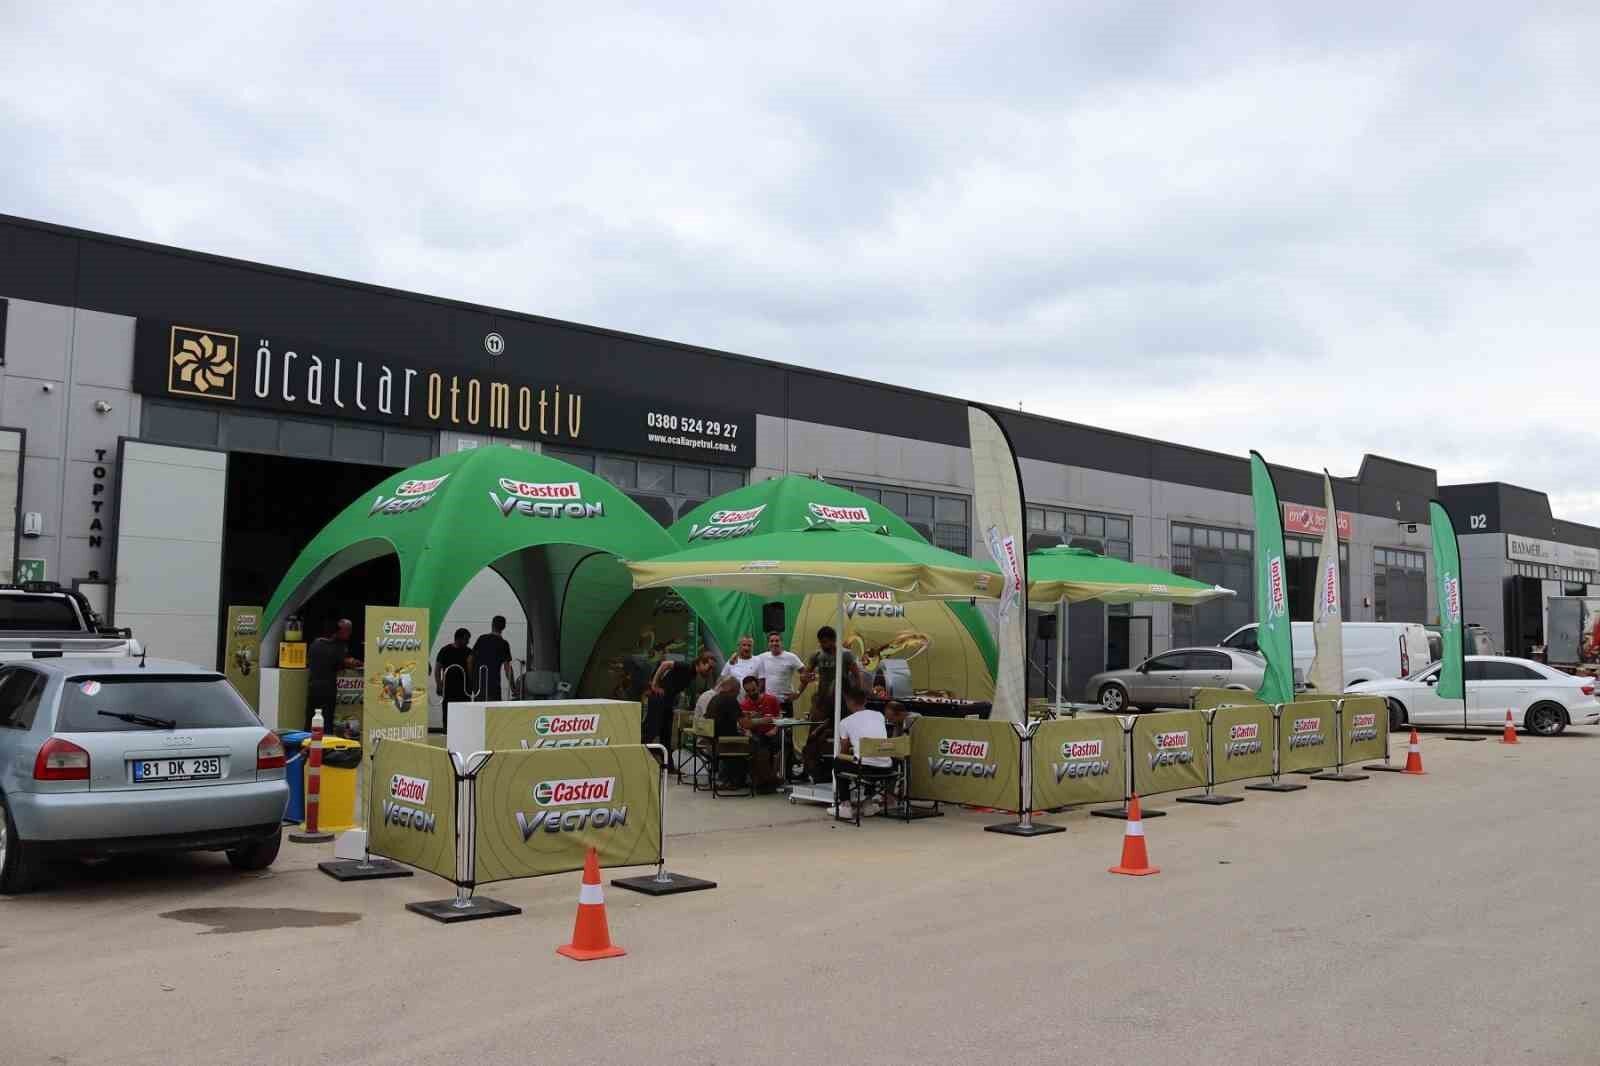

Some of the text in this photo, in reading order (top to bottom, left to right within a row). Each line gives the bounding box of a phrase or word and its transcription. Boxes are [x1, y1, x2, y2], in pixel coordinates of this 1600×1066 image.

[647, 412, 738, 438] 0380 524 29 27
[89, 449, 106, 547] TOPTAN
[518, 483, 577, 498] Castrol
[489, 491, 606, 518] VECTON
[822, 507, 867, 520] Castrol
[1470, 514, 1487, 528] D2
[551, 715, 596, 733] Castrol
[950, 740, 985, 758] Castrol
[1163, 733, 1186, 747] Castrol
[1072, 741, 1100, 758] Castrol
[143, 759, 218, 776] 81 DK 295
[397, 777, 426, 801] Castrol
[554, 779, 610, 801] Castrol
[383, 800, 436, 834] VECTON
[515, 805, 628, 842] VECTON
